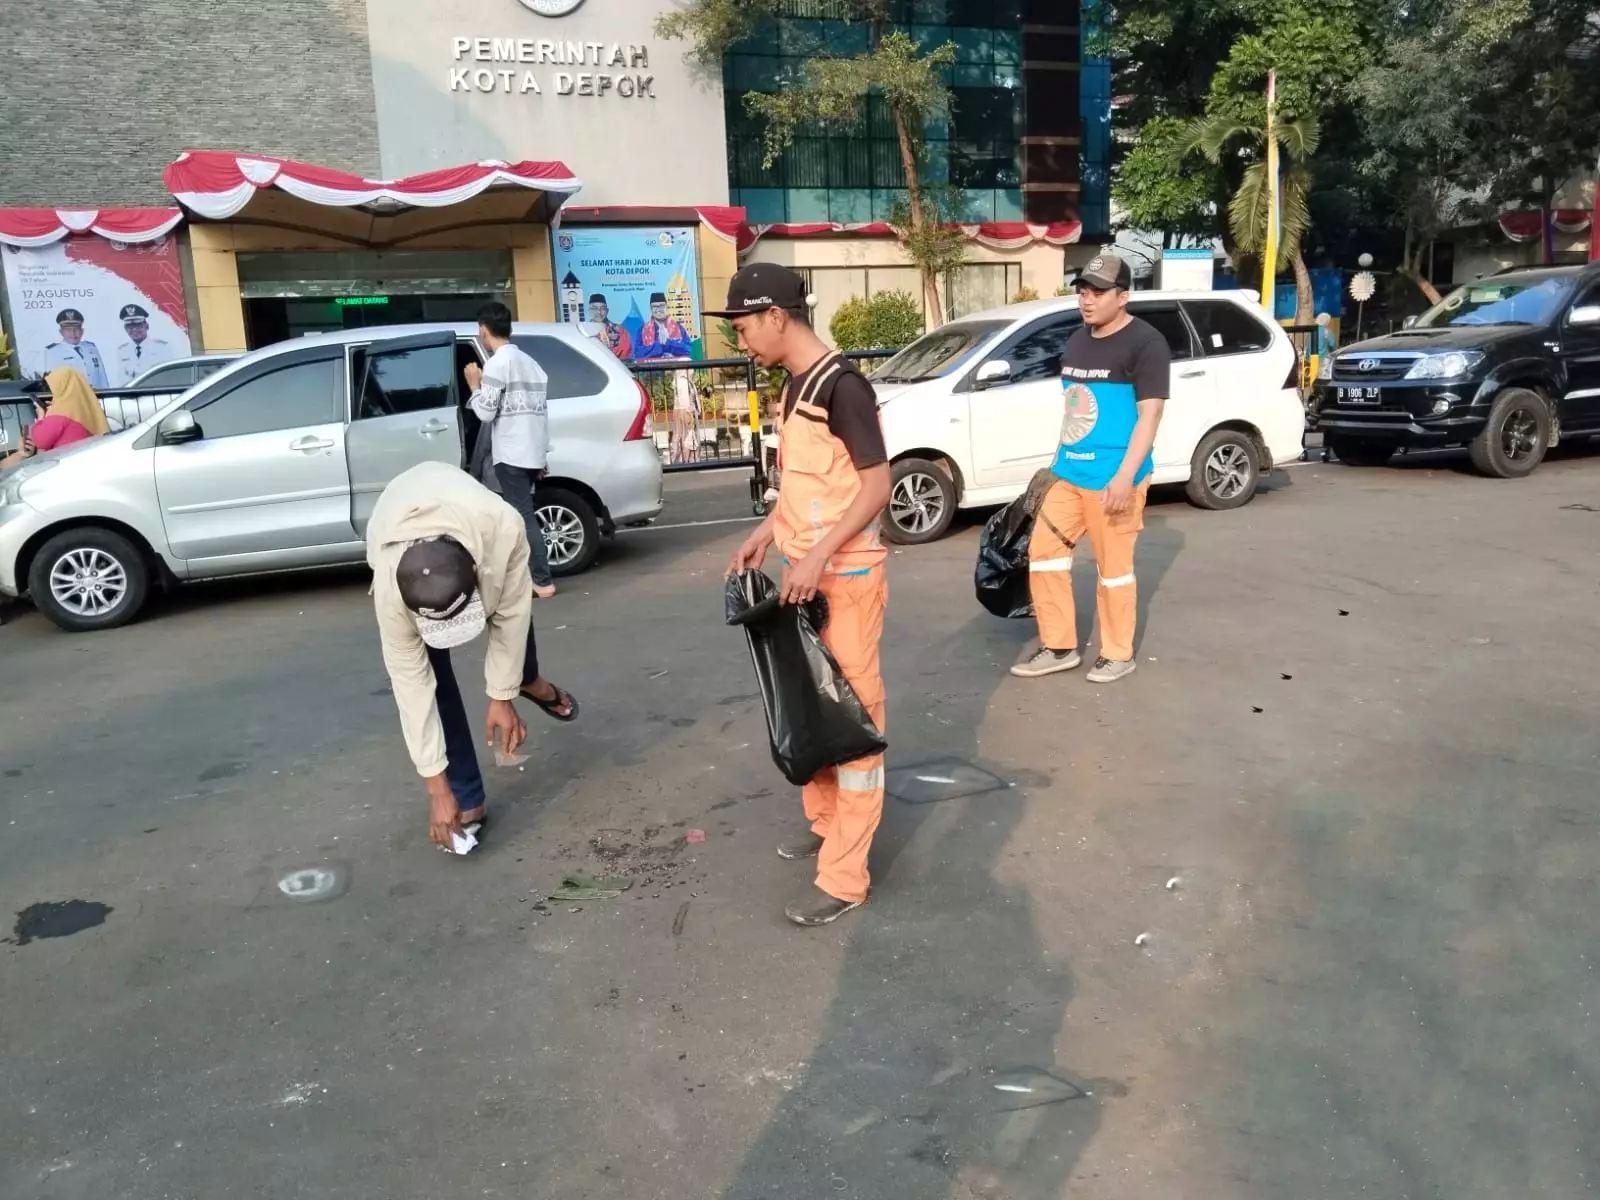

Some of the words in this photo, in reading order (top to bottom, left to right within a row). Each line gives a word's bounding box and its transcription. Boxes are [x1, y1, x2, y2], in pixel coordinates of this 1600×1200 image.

[453, 36, 649, 69] PEMERINTAH
[450, 67, 542, 96] KOTA
[556, 72, 656, 98] DEPOK
[580, 259, 613, 267] SELAMAT
[615, 258, 632, 266] HARI
[634, 258, 650, 266] JADI
[626, 267, 650, 275] DEPOK
[22, 289, 34, 299] 17
[36, 288, 94, 299] AGUSTUS
[24, 300, 54, 310] 2023
[1366, 387, 1379, 398] ZLP
